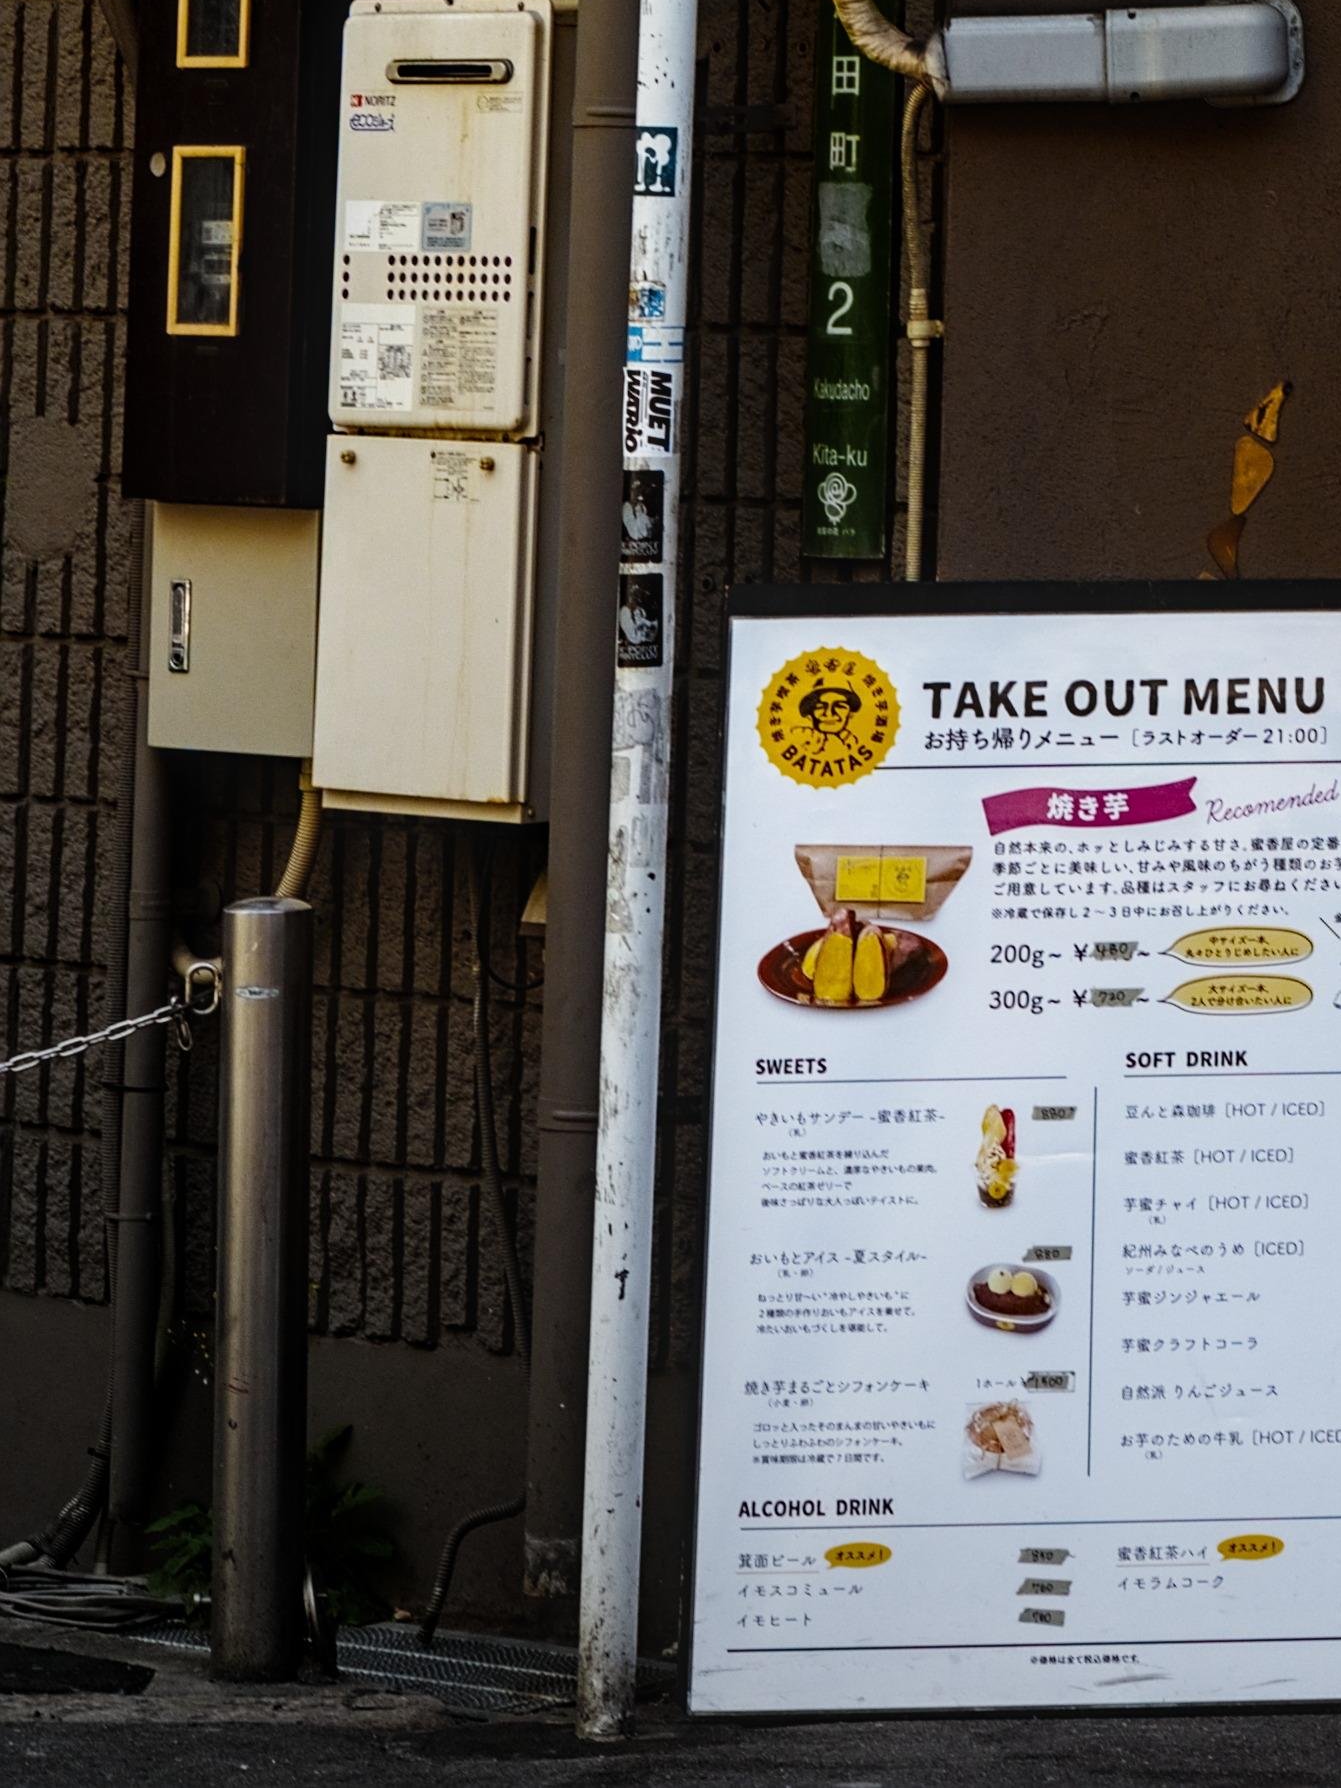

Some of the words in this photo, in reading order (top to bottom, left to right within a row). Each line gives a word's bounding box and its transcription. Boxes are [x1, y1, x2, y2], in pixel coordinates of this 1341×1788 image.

[826, 280, 854, 336] 2
[814, 375, 871, 401] Kakudacho
[811, 442, 869, 467] Kita-ku
[922, 680, 1048, 719] TAKE
[1064, 678, 1168, 717] OUT
[1183, 676, 1326, 716] MENU
[924, 728, 1119, 750] お持ち帰りメニュー
[781, 744, 874, 777] BATATAS
[1046, 791, 1130, 822] 焼き芋
[1205, 779, 1339, 824] Recomended
[755, 1057, 828, 1075] SWEETS
[1126, 1052, 1175, 1068] SOFT
[1186, 1050, 1249, 1067] DRINK
[738, 1499, 826, 1518] ALCOHOL
[836, 1498, 895, 1516] DRINK
